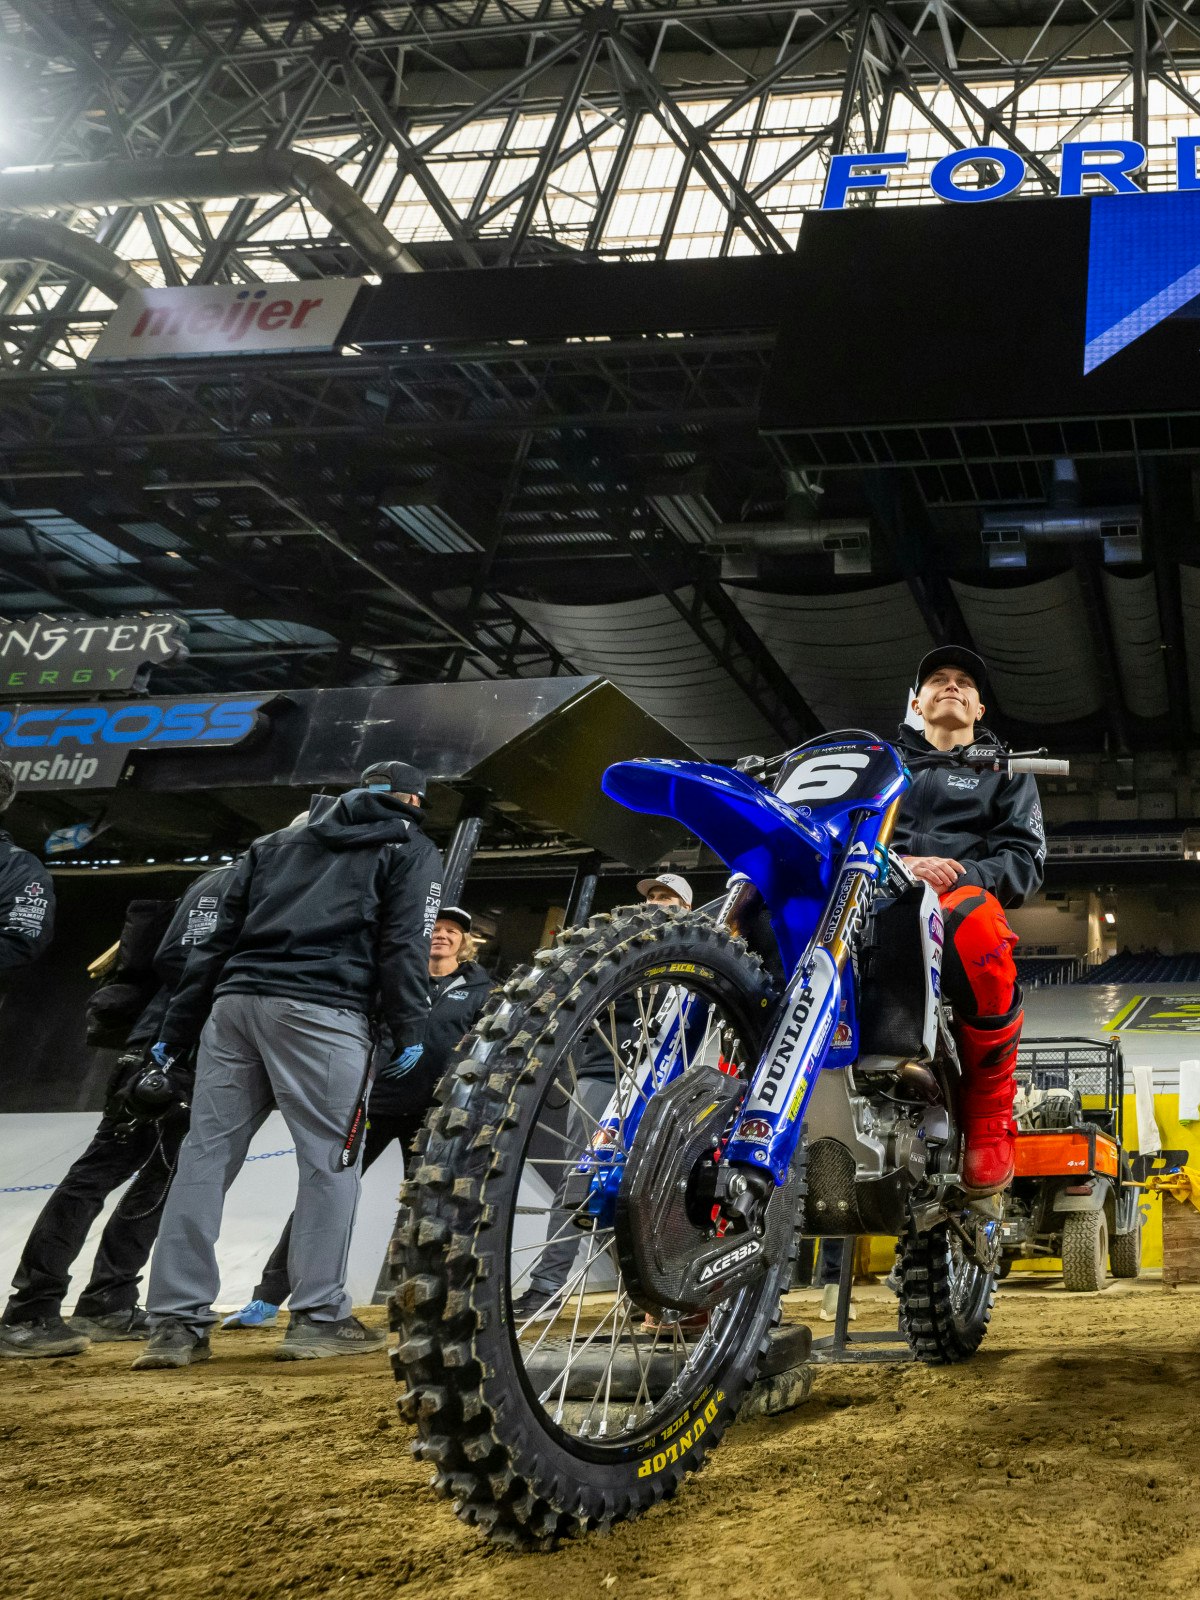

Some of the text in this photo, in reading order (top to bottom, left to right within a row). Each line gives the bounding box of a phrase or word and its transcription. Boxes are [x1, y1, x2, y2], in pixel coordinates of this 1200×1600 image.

[131, 290, 324, 343] meijer
[0, 622, 173, 661] NSTER
[7, 667, 127, 686] ERGY
[0, 701, 265, 747] CROSS
[776, 753, 870, 804] 6
[15, 896, 48, 908] FXR
[823, 869, 860, 944] enzoracing
[669, 963, 696, 973] EXCEL
[758, 985, 815, 1106] DUNLOP
[700, 1241, 760, 1281] ACERBIS
[638, 1399, 718, 1478] DUNLOP
[660, 1409, 690, 1441] EXCEL
